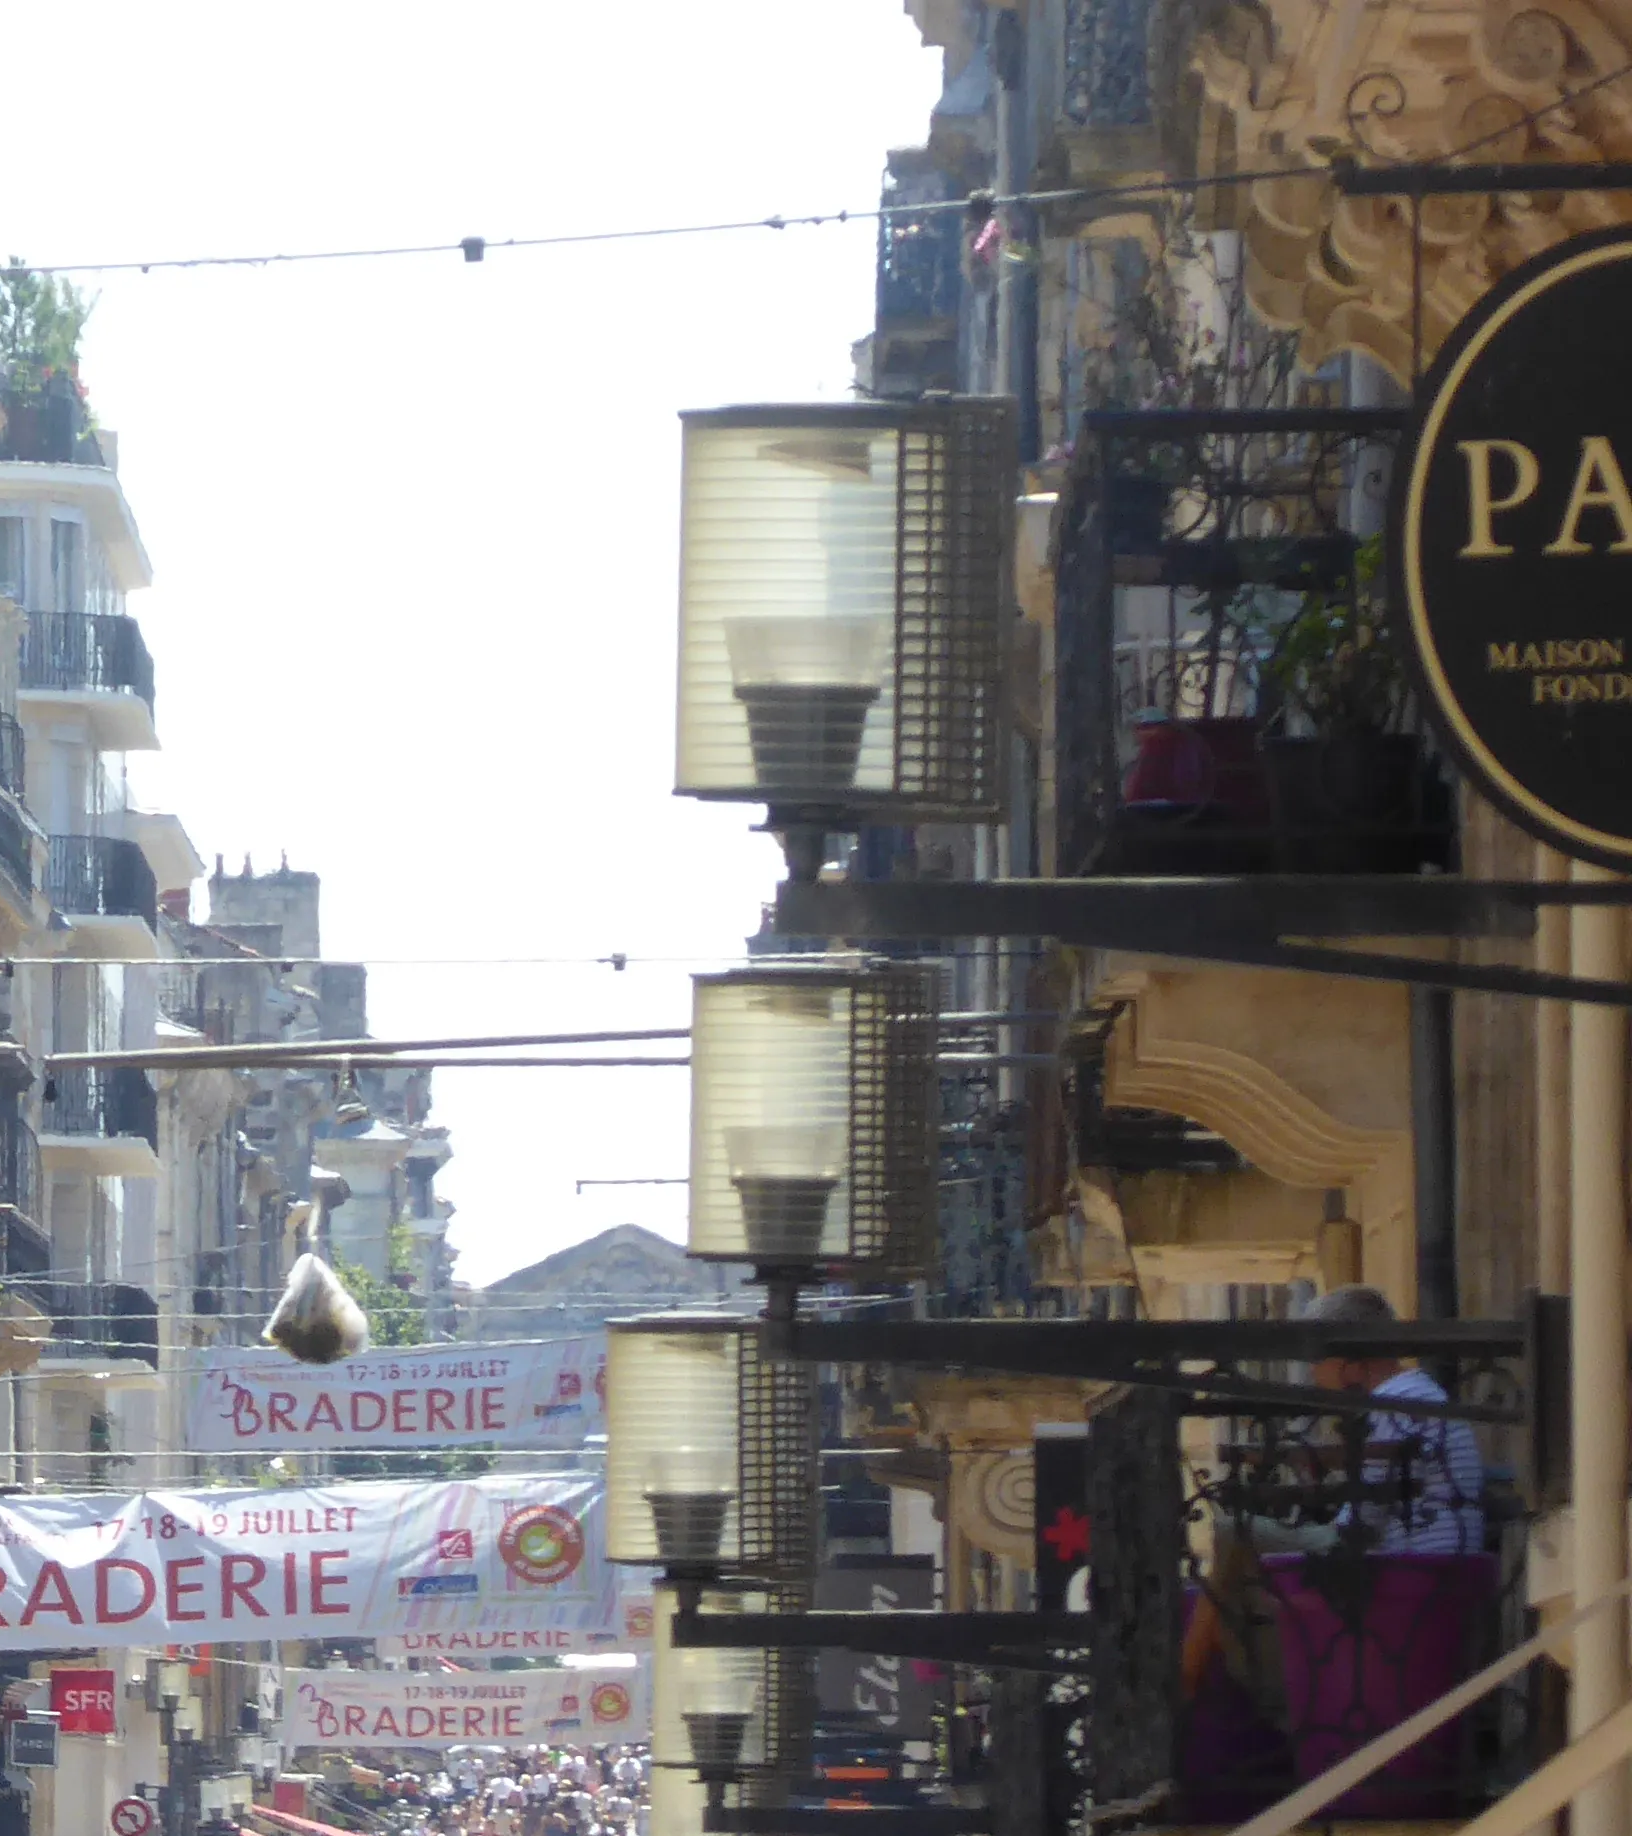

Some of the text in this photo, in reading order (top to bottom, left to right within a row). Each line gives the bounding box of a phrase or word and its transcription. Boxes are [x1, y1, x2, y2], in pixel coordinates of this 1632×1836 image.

[1487, 638, 1623, 671] MAISON
[221, 1386, 506, 1438] BRADERIE
[237, 1506, 358, 1535] JUILLET
[64, 1689, 113, 1711] SFR
[316, 1704, 524, 1738] BRADERIE
